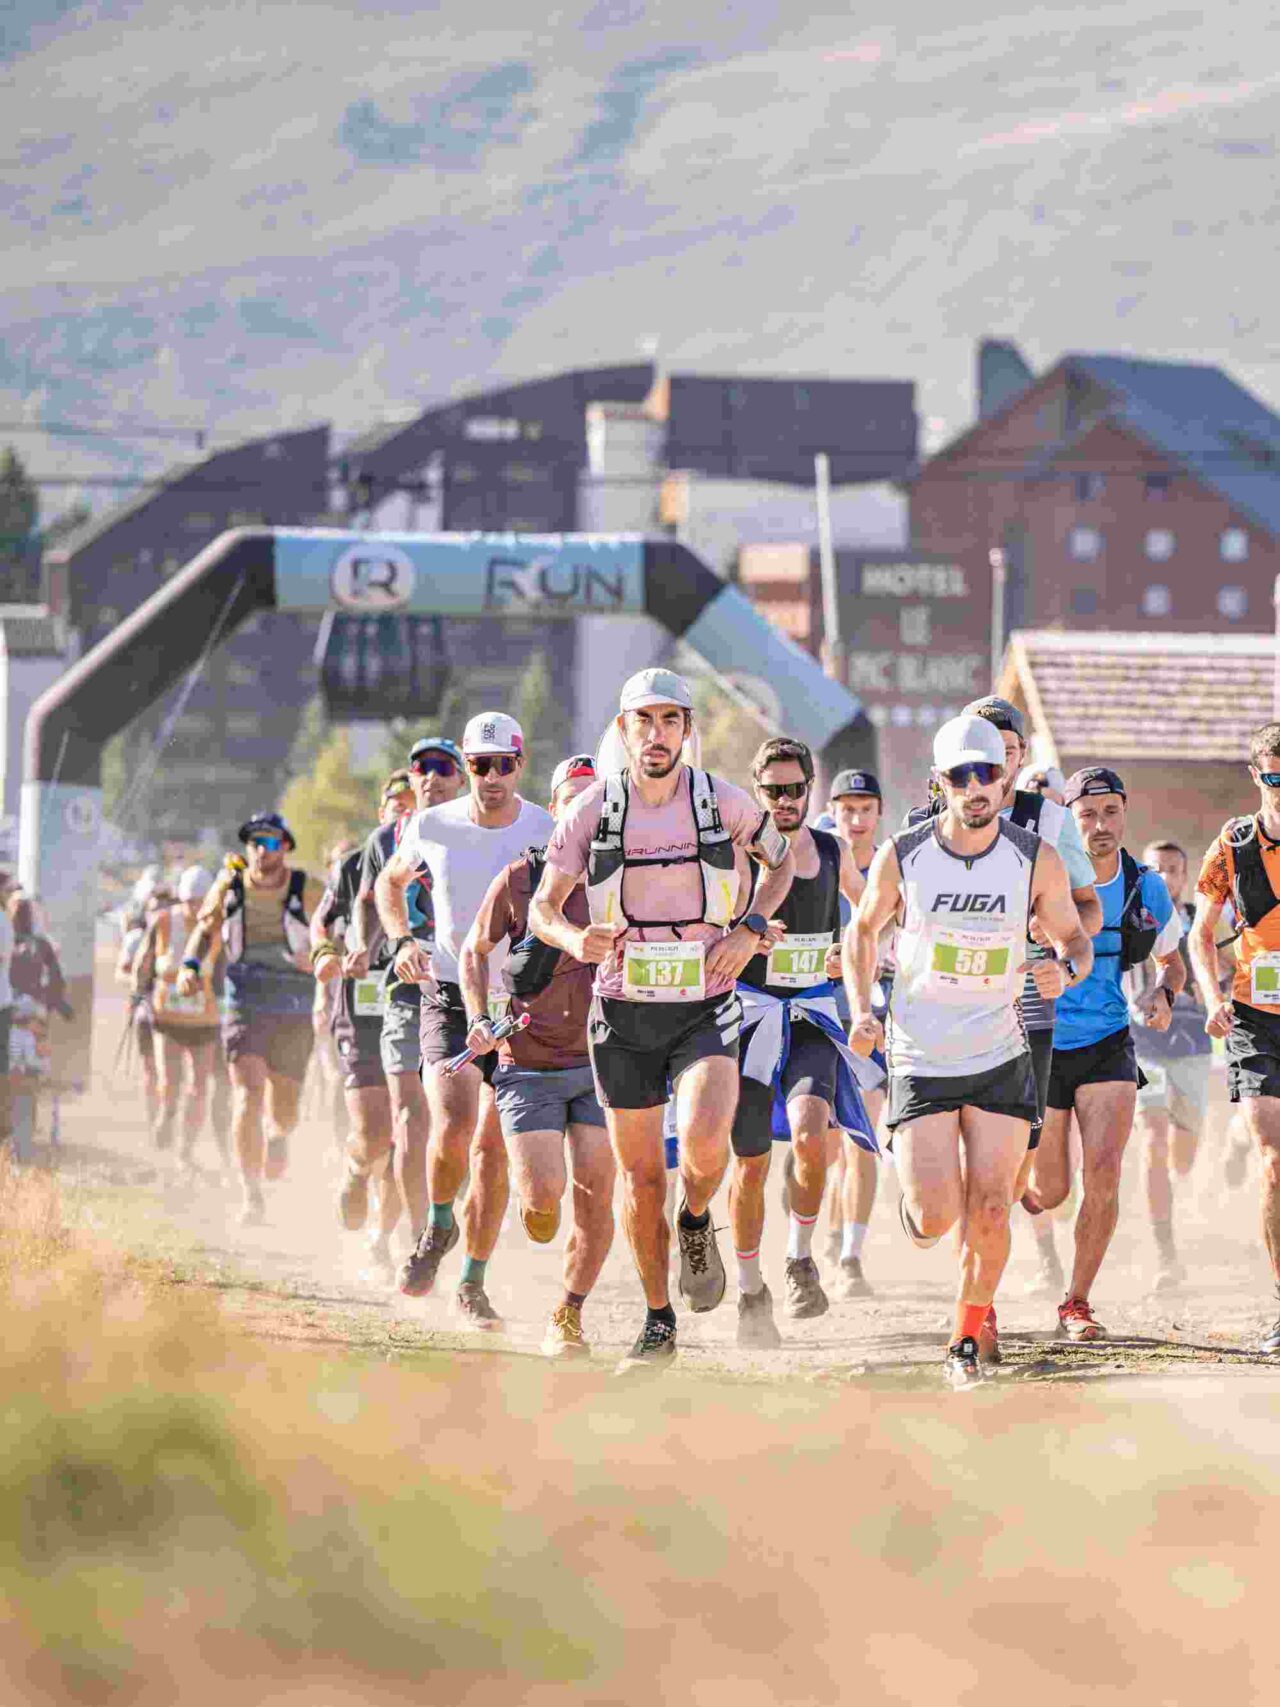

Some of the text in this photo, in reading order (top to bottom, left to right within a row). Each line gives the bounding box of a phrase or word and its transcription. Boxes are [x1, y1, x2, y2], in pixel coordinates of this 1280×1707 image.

[486, 557, 625, 608] RUN
[862, 563, 968, 596] HOTEL
[931, 894, 1006, 913] FUGA
[645, 961, 684, 986] 137
[789, 950, 819, 973] 147
[955, 949, 989, 975] 58
